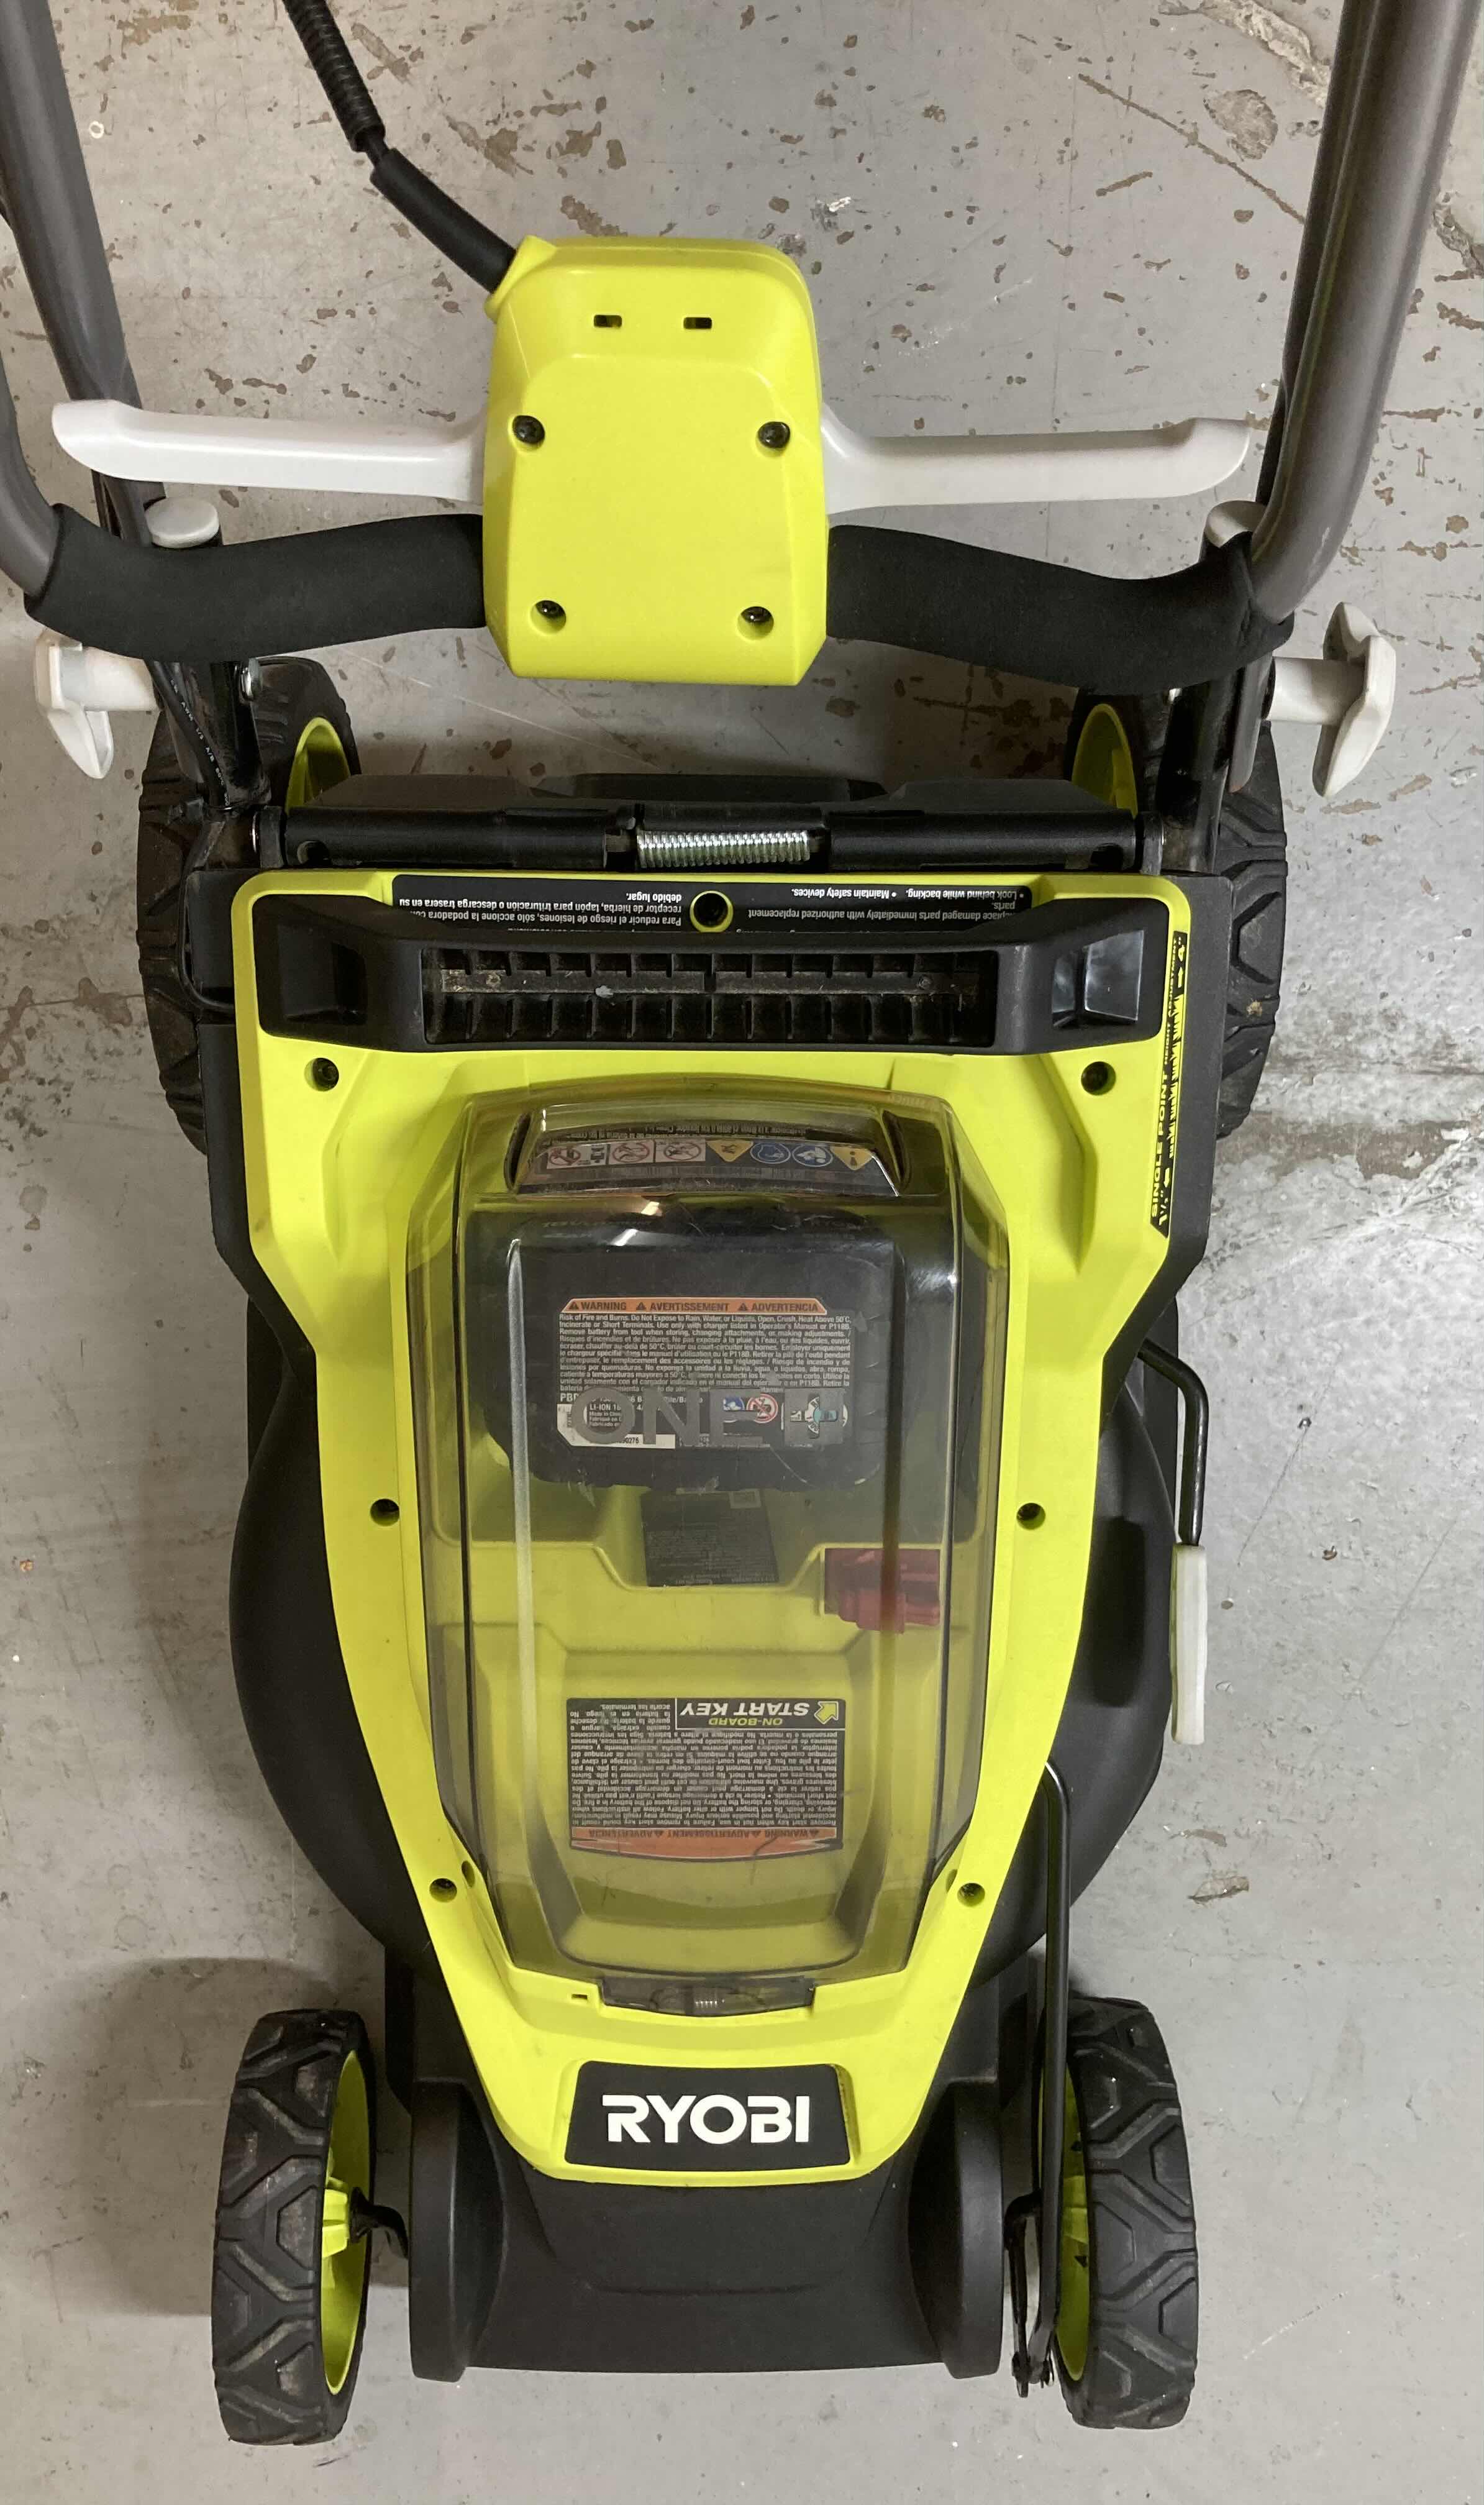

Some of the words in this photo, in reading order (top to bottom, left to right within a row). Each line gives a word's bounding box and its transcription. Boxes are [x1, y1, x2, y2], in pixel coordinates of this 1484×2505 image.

[626, 892, 650, 902] lugar.
[791, 890, 825, 898] devices.
[827, 888, 852, 898] safety
[854, 890, 889, 898] Maintain
[906, 888, 941, 898] backing.
[943, 890, 965, 899] while
[968, 890, 995, 899] behind
[997, 890, 1017, 899] Look
[653, 894, 681, 903] debido
[424, 900, 455, 909] trasera
[457, 899, 496, 910] descarga
[506, 901, 551, 910] trituración
[553, 900, 573, 909] para
[575, 901, 599, 911] tapón
[601, 901, 630, 912] hierba,
[633, 903, 643, 912] de
[645, 902, 681, 913] receptor
[992, 901, 1015, 910] parts.
[429, 911, 468, 921] podadora
[471, 913, 480, 921] la
[482, 913, 514, 922] accione
[517, 914, 535, 923] sólo
[537, 913, 575, 923] lesiones,
[578, 915, 588, 923] de
[590, 913, 616, 924] riesgo
[749, 909, 799, 919] replacement
[802, 911, 844, 919] authorized
[847, 911, 864, 919] with
[867, 910, 916, 920] immediately
[919, 910, 940, 920] parts
[943, 910, 980, 920] damaged
[619, 916, 626, 924] el
[629, 916, 660, 924] reducir
[662, 916, 681, 925] Para
[1167, 938, 1177, 1018] ADJUSTMENT
[1163, 1023, 1172, 1065] HEIGHT
[1158, 1068, 1168, 1135] POINT
[1152, 1142, 1163, 1217] SINGLE
[581, 1302, 627, 1310] WARNING
[650, 1302, 729, 1311] AVERTISSEMENT
[752, 1303, 818, 1312] ADVERTENCIA
[680, 1703, 728, 1715] KEY
[733, 1703, 809, 1715] START
[602, 2094, 810, 2145] RYOBI
